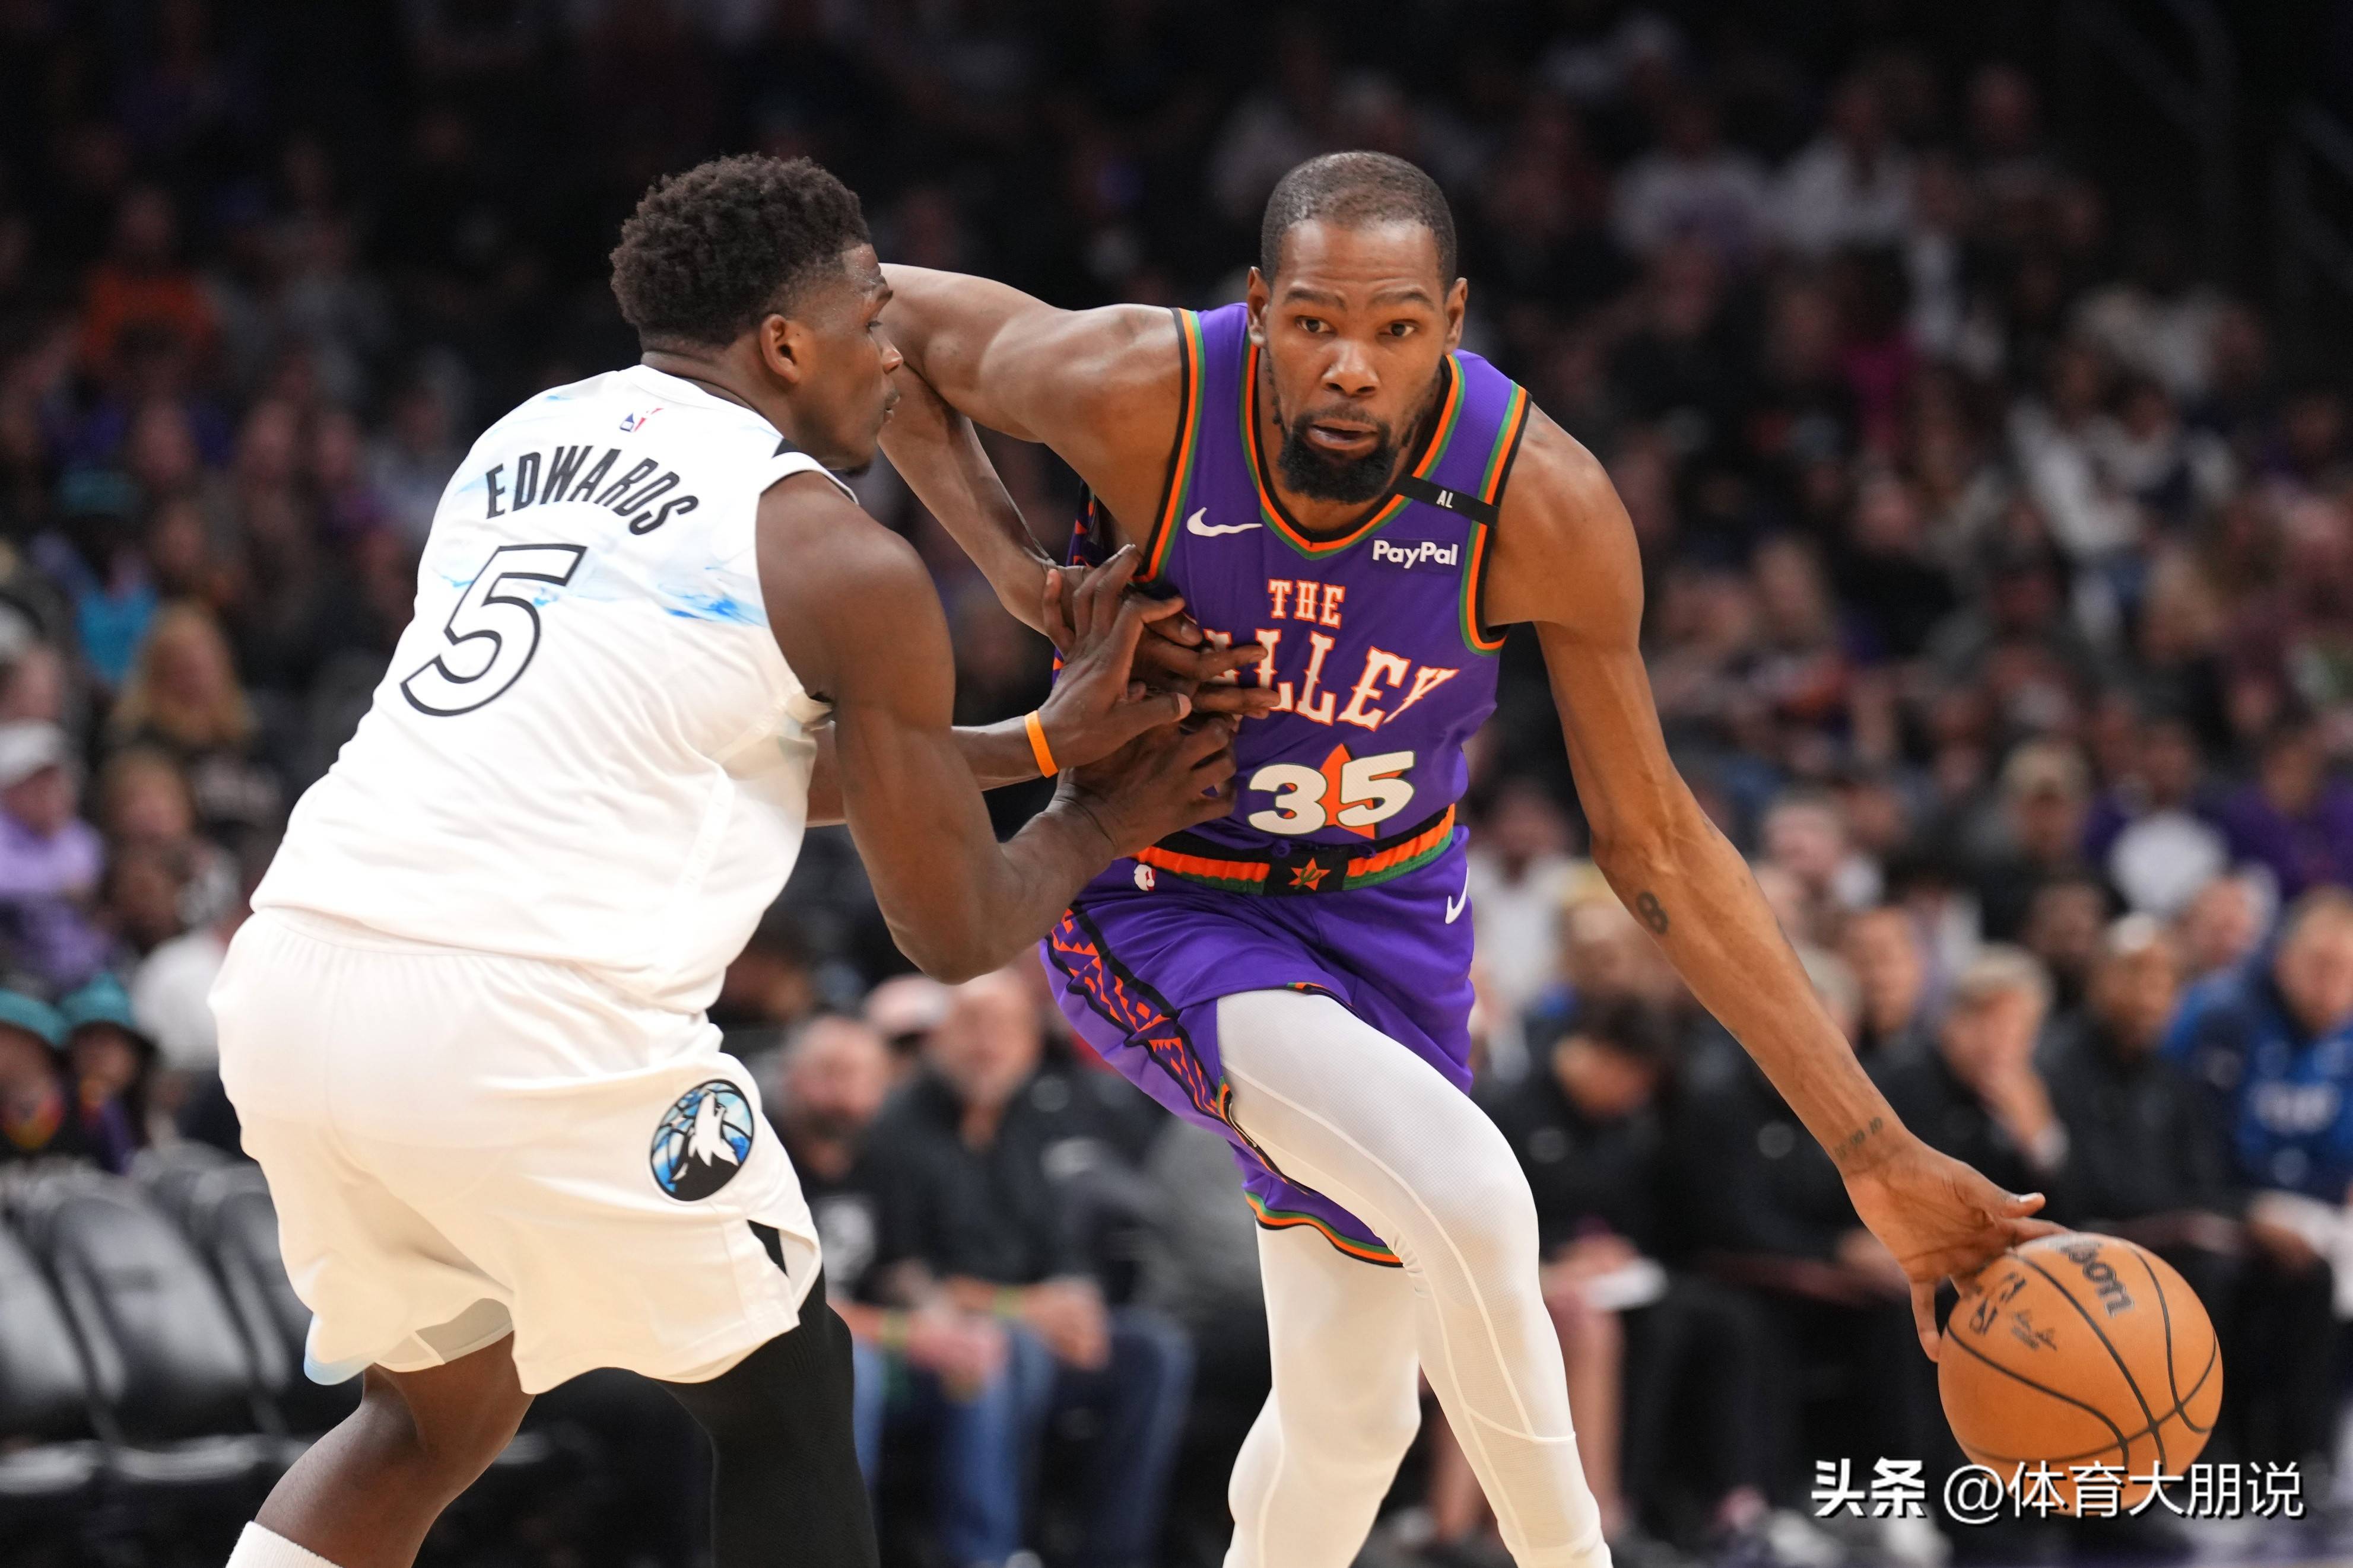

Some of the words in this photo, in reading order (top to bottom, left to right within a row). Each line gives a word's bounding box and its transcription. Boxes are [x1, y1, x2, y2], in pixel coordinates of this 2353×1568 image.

[485, 445, 698, 536] EDWARDS
[1436, 489, 1454, 509] AL
[1372, 539, 1459, 570] PayPal
[399, 543, 588, 717] 5
[1268, 578, 1347, 630] THE
[1248, 750, 1415, 835] 35
